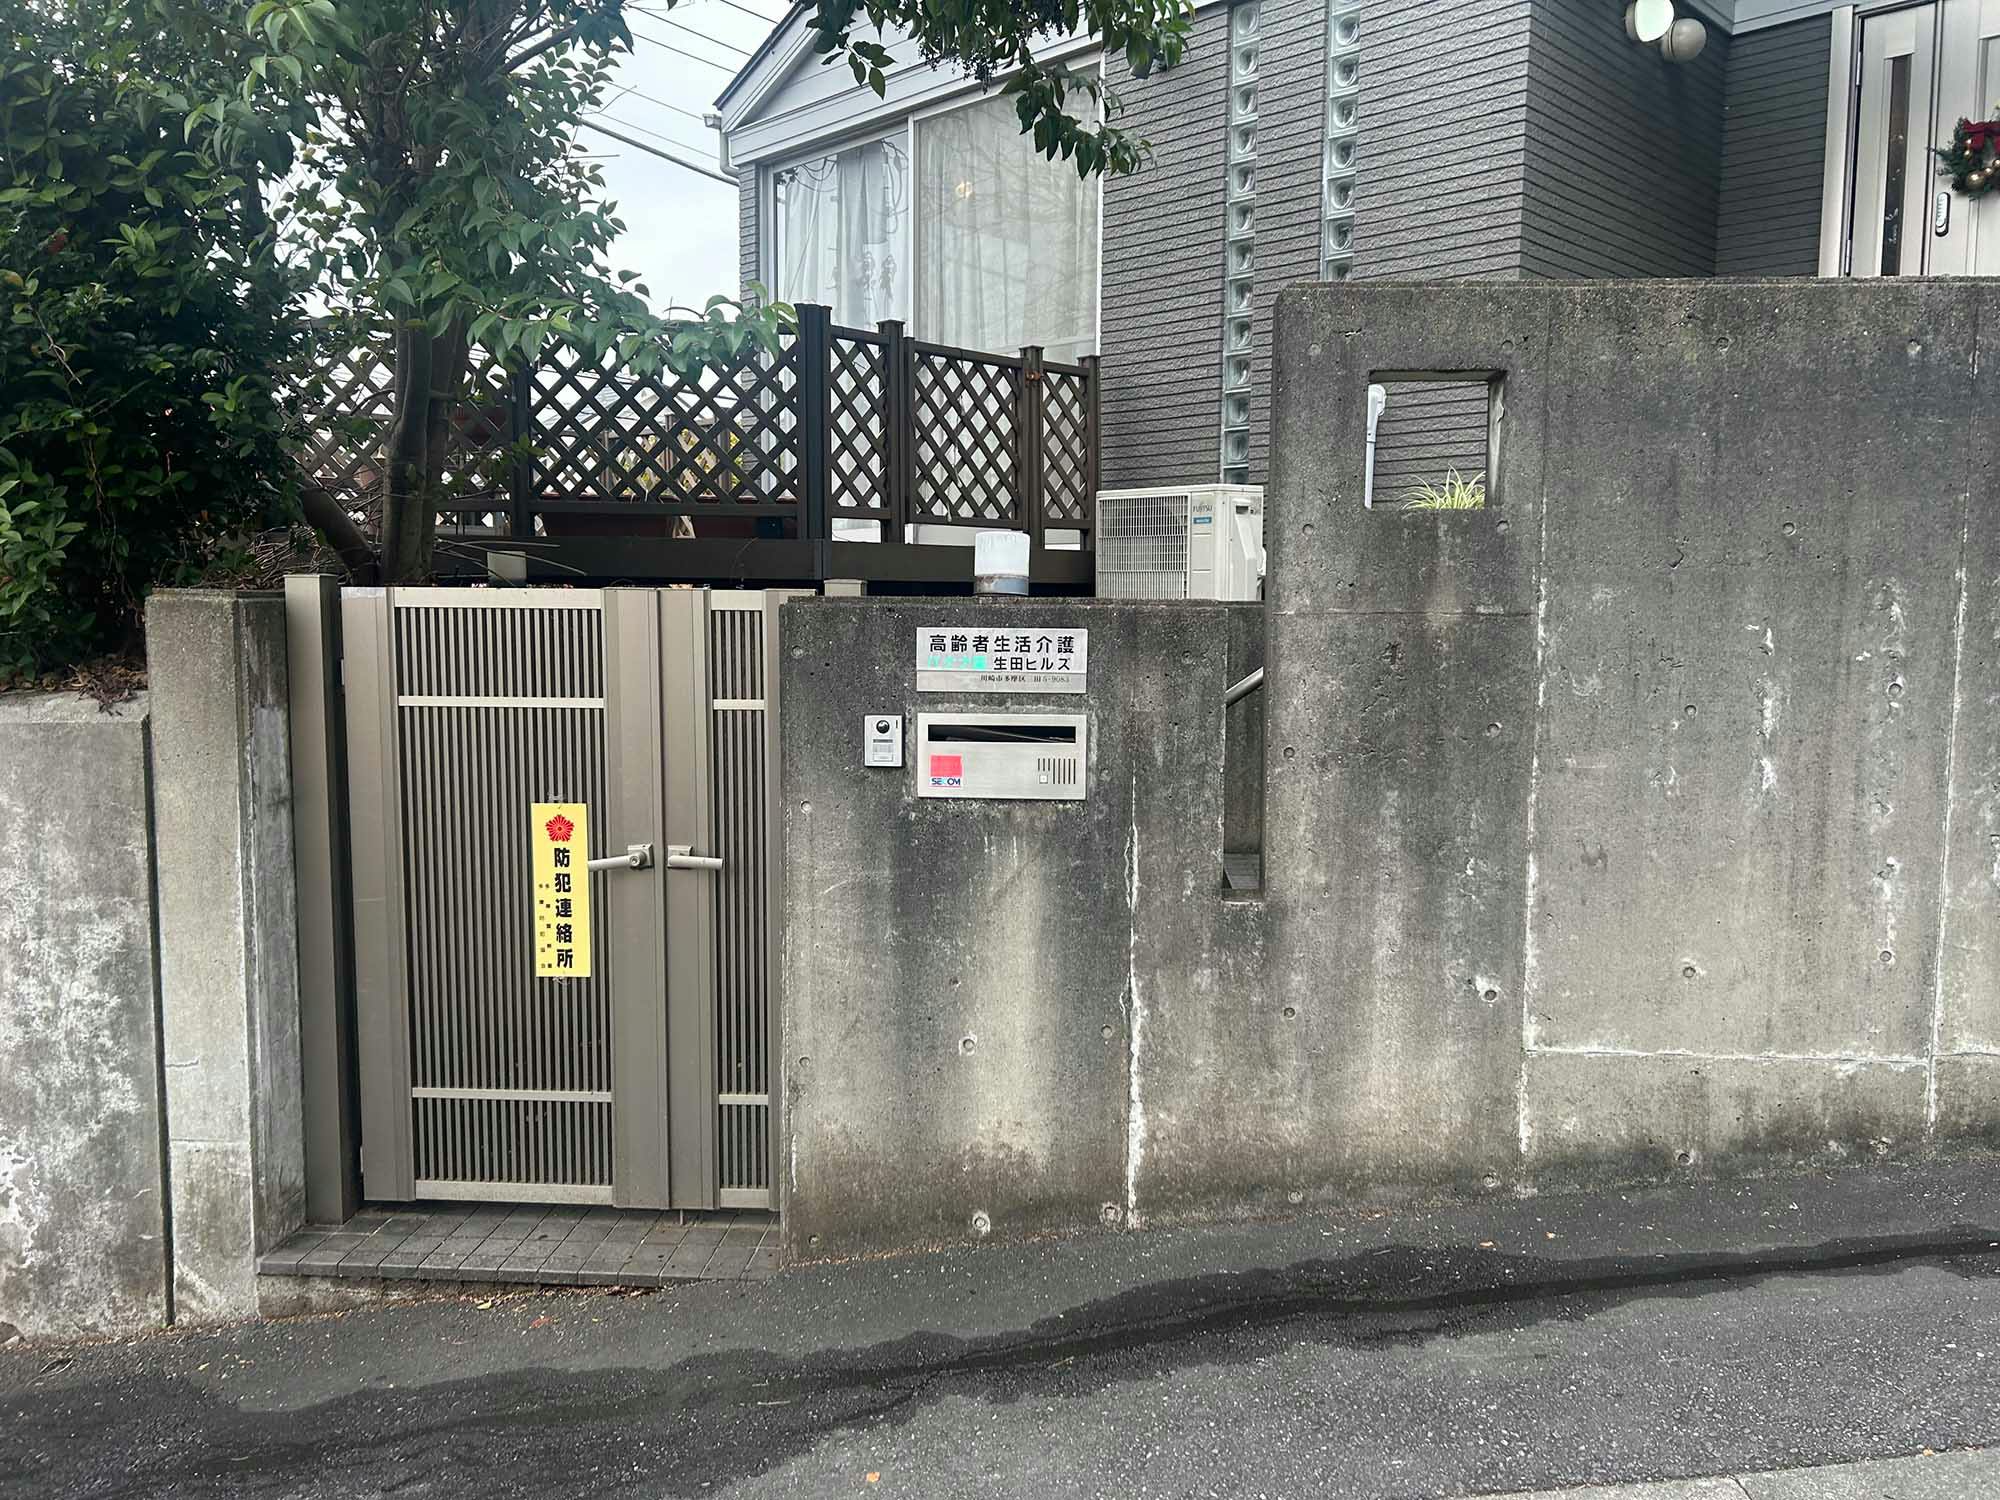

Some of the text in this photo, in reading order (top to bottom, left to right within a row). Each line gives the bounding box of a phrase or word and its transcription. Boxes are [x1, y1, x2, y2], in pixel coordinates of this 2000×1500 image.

[929, 634, 1075, 654] 高齢者生活介護
[993, 656, 1071, 671] 生田ヒルズ
[553, 847, 574, 969] 防犯連絡所
